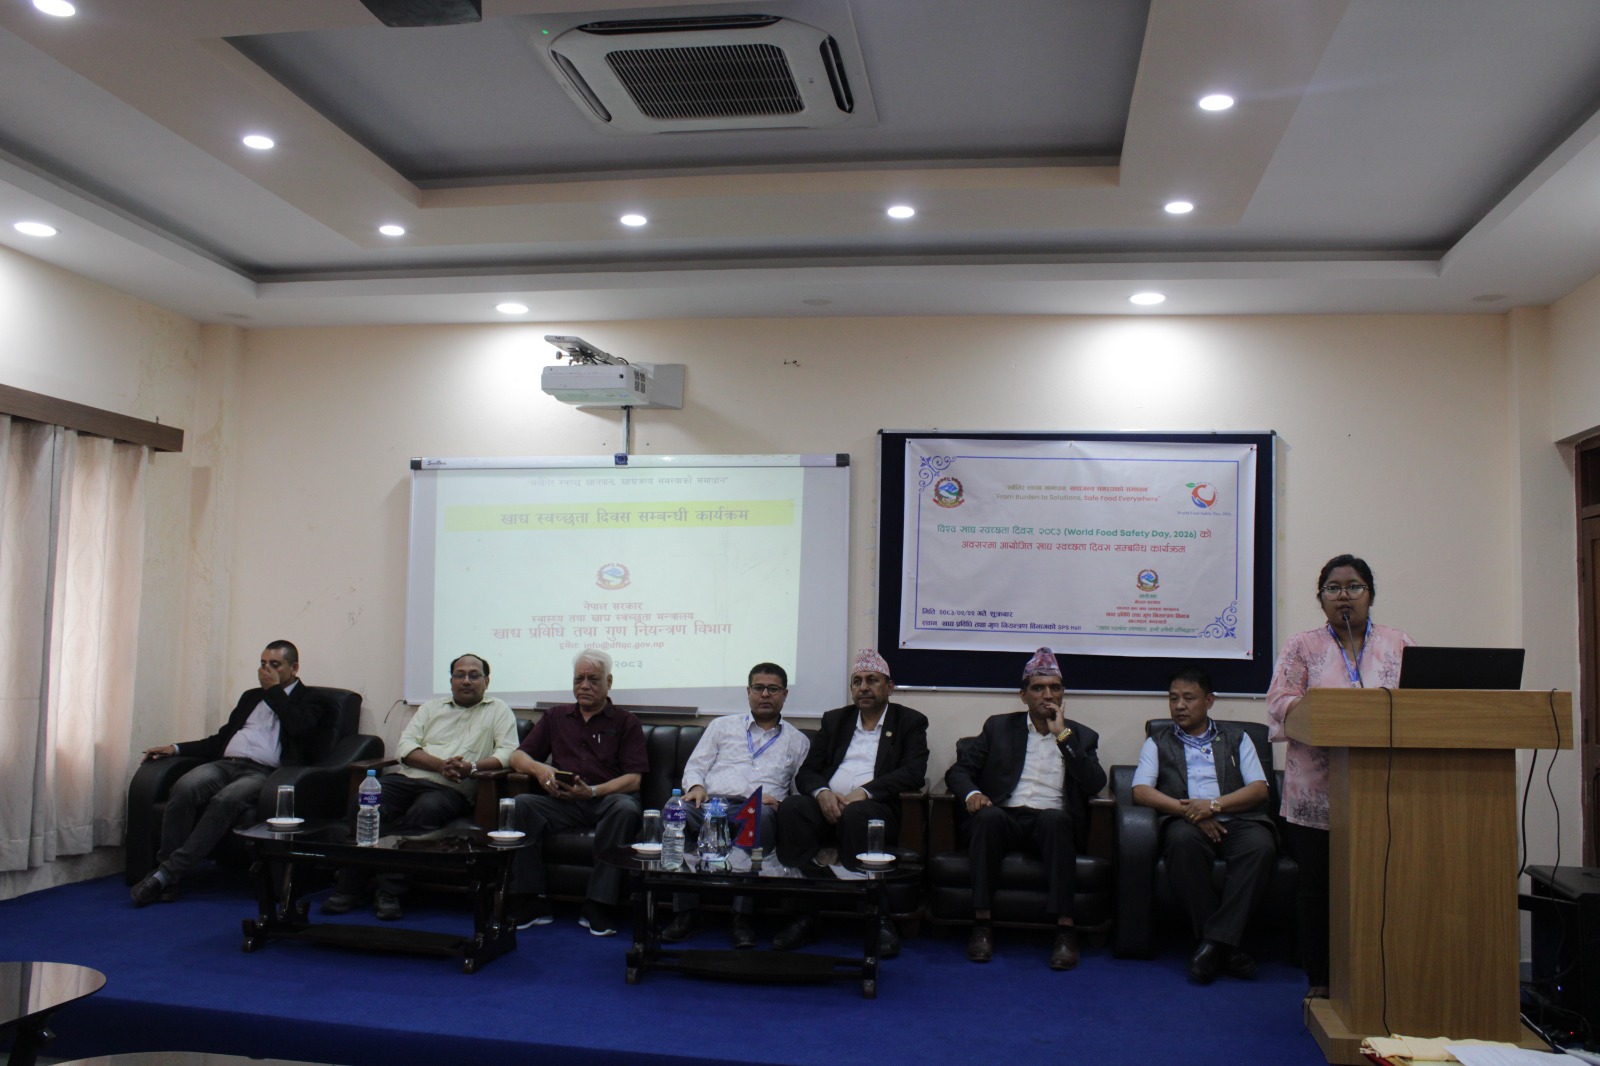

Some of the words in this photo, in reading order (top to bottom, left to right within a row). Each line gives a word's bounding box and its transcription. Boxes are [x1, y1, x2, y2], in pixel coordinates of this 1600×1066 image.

[499, 513, 530, 525] खाद्य
[536, 511, 589, 526] स्वच्छता
[596, 508, 631, 523] दिवस
[637, 507, 688, 523] सम्बन्धी
[695, 506, 749, 521] कार्यक्रम
[937, 524, 957, 533] विश्व
[960, 526, 976, 534] खाद्य
[979, 526, 1009, 535] स्वच्छता
[1038, 527, 1060, 536] २०८३
[1064, 528, 1094, 536] (World
[1095, 529, 1118, 537] Food
[1120, 529, 1149, 538] Safety
[1151, 530, 1172, 539] Day,
[1173, 530, 1197, 539] 2026)
[1199, 529, 1212, 539] को
[961, 540, 997, 549] अवसरमा
[1000, 539, 1033, 550] आयोजित
[1035, 543, 1053, 551] खाद्य
[1056, 543, 1087, 551] स्वच्छता
[1089, 541, 1111, 552] दिवस
[1150, 543, 1186, 553] कार्यक्रम
[583, 601, 607, 611] नेपाल
[612, 602, 643, 611] सरकार
[569, 614, 586, 622] तथा
[591, 613, 611, 622] खाद्य
[616, 612, 652, 623] स्वच्छता
[656, 612, 694, 621] मन्त्रालय
[492, 628, 522, 639] खाद्य
[529, 623, 566, 639] प्रविधि
[573, 626, 598, 638] तथा
[605, 625, 627, 641] गुण
[634, 622, 687, 637] नियन्त्रण
[694, 620, 732, 635] विभाग
[584, 640, 664, 651] info@dftqc.gov.np
[614, 660, 643, 669] २०८३
